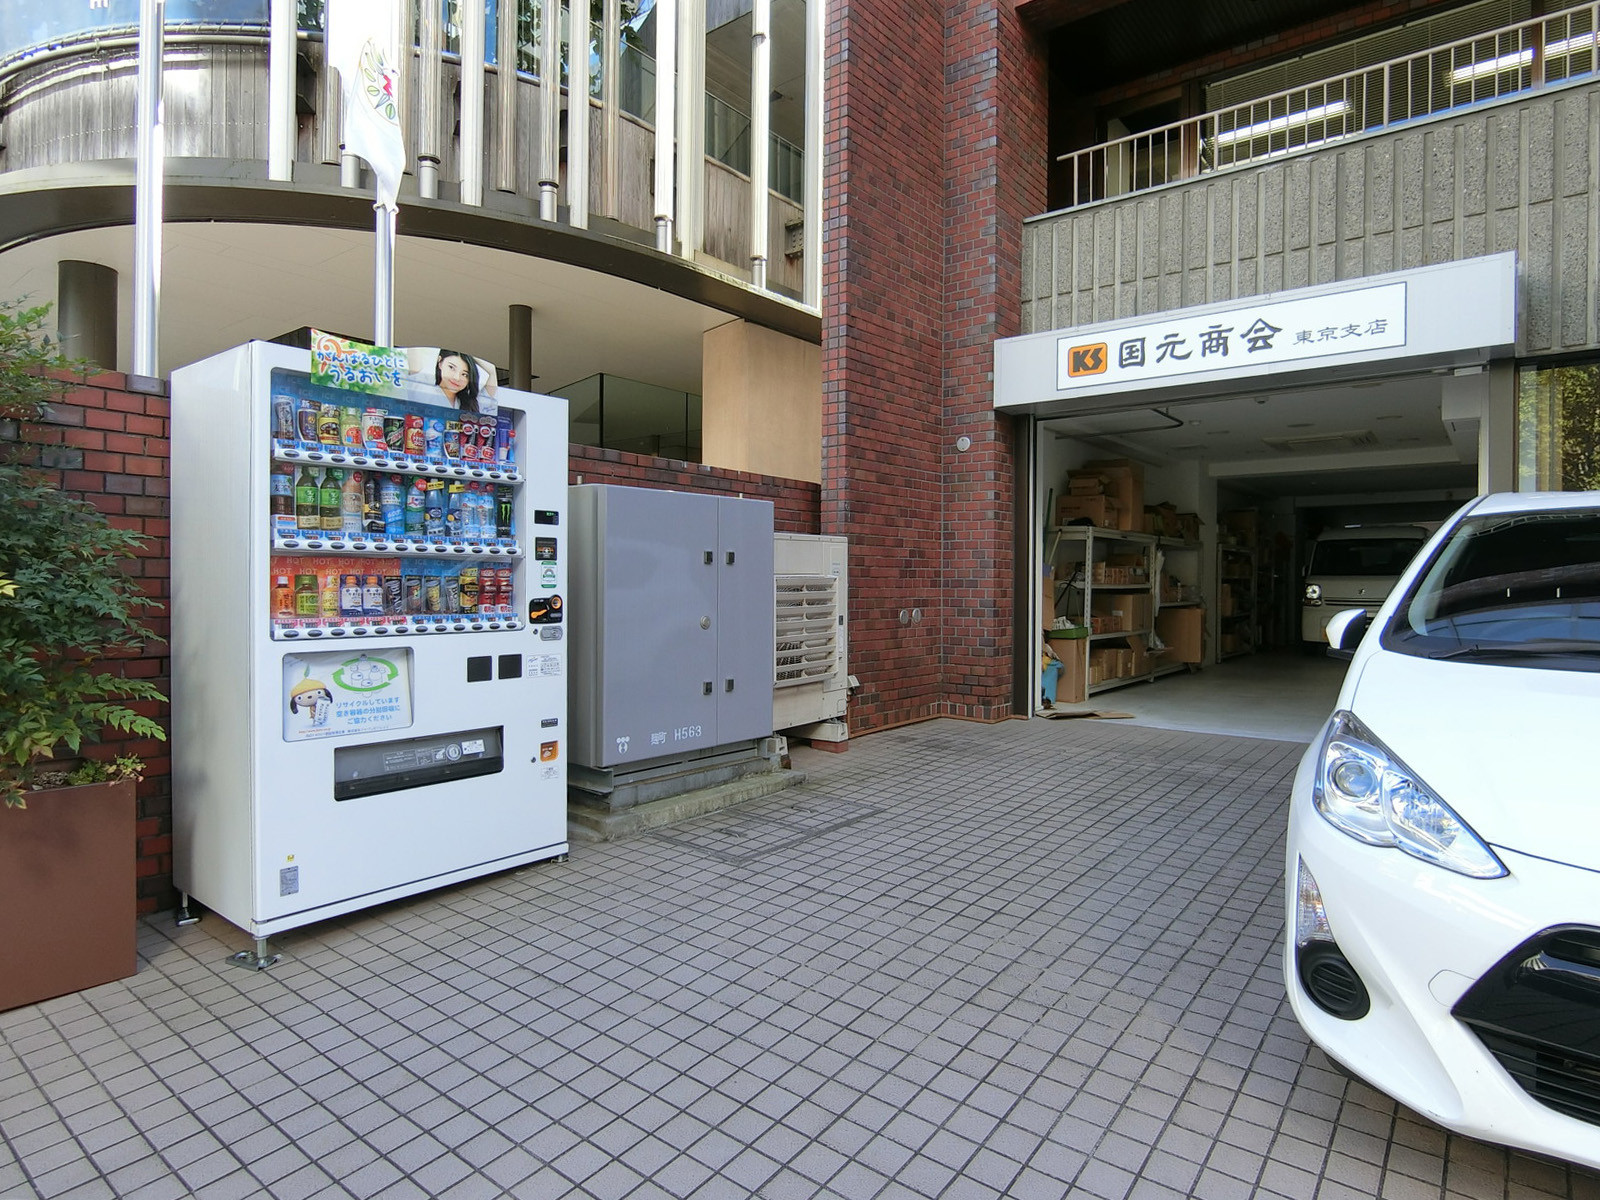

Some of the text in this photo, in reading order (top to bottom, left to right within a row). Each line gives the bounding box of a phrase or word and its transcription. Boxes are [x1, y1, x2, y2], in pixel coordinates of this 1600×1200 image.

[1118, 318, 1388, 369] 国元商会 東京支店
[316, 351, 405, 369] がんばるひとに
[1072, 348, 1103, 374] KS
[329, 365, 402, 388] うるおいを
[313, 557, 331, 566] HOT
[325, 568, 343, 576] HOT
[336, 696, 400, 709] リサイクルしています
[347, 715, 392, 725] ご協力ください
[674, 725, 702, 741] H563
